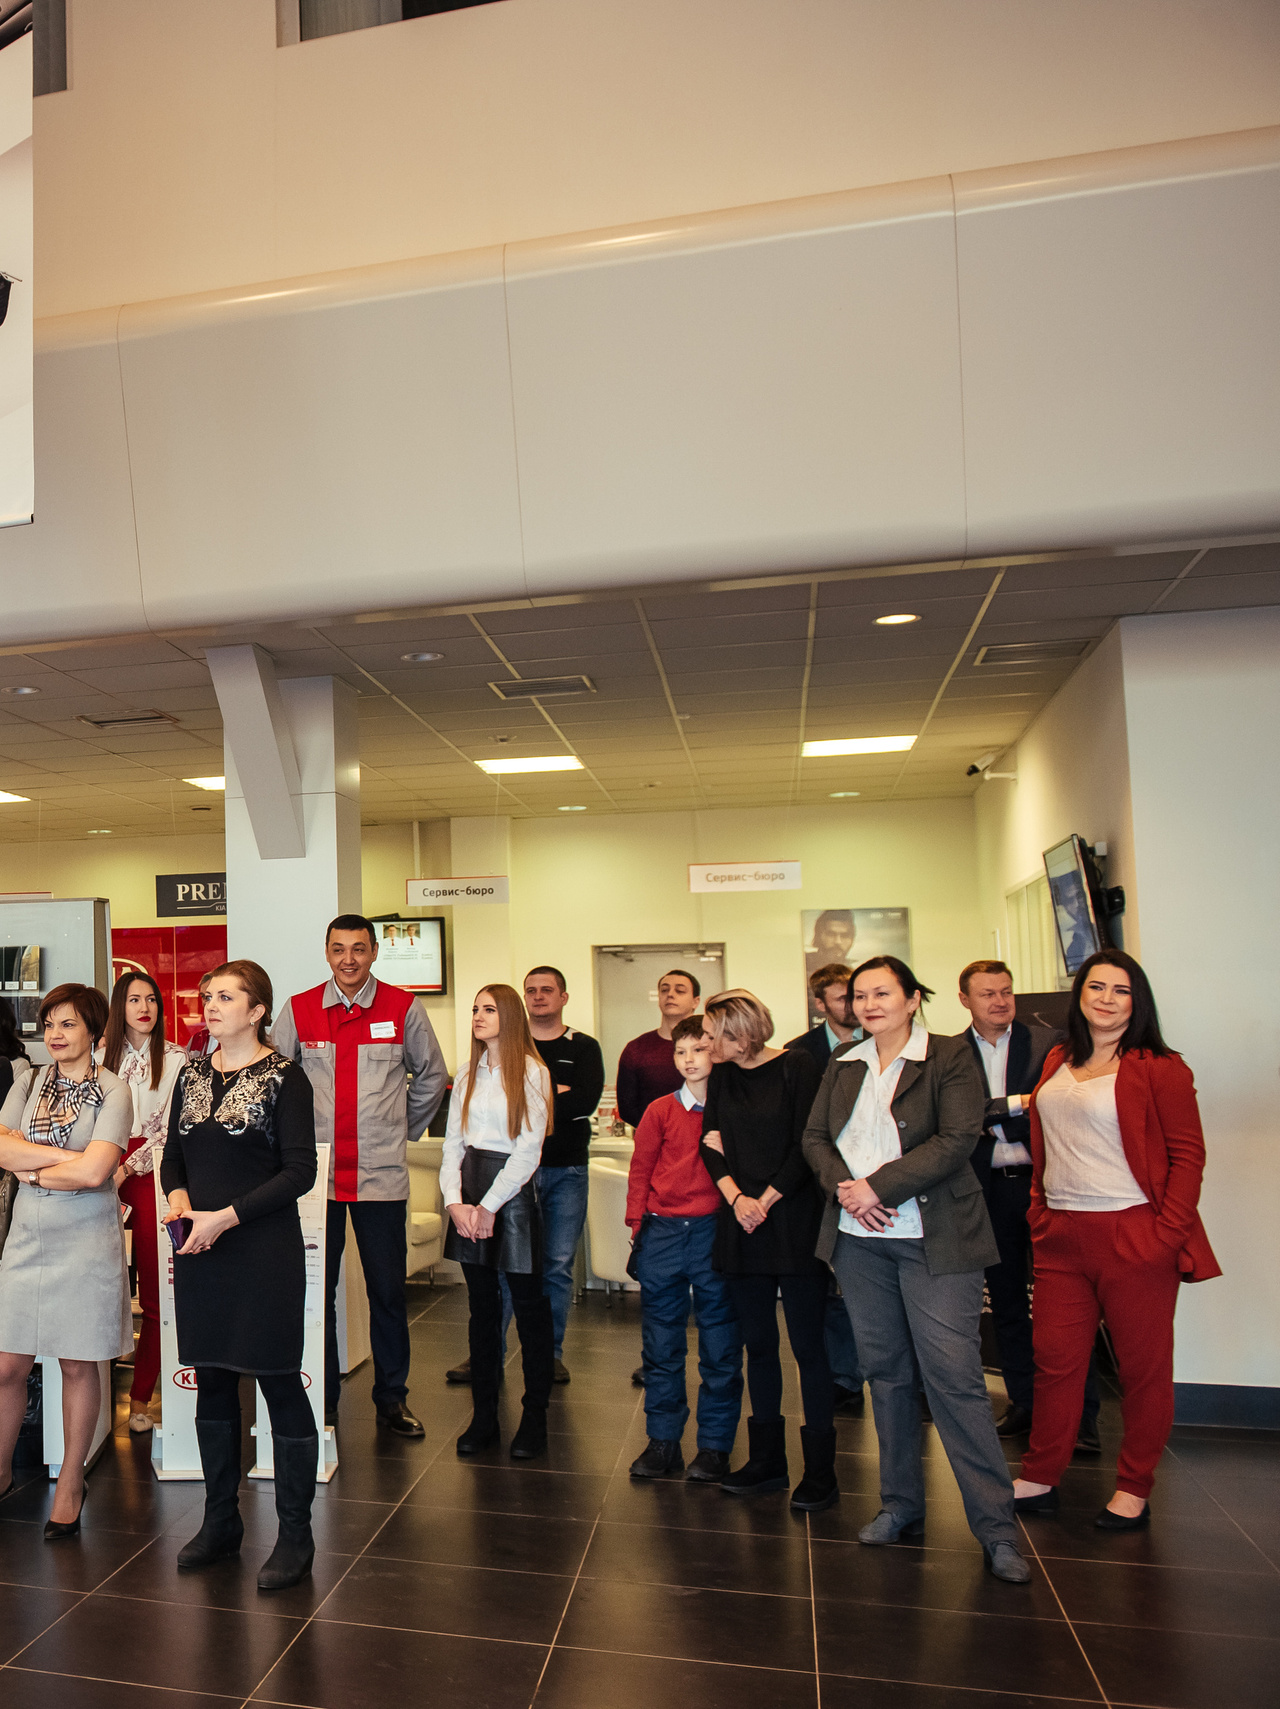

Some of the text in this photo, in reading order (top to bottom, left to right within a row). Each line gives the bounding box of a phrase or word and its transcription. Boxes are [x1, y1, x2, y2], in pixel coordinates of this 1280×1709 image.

[705, 871, 785, 884] Сервис-бюро
[176, 882, 226, 901] PRE
[422, 886, 494, 898] Сервис-бюро
[181, 1372, 197, 1384] KI
